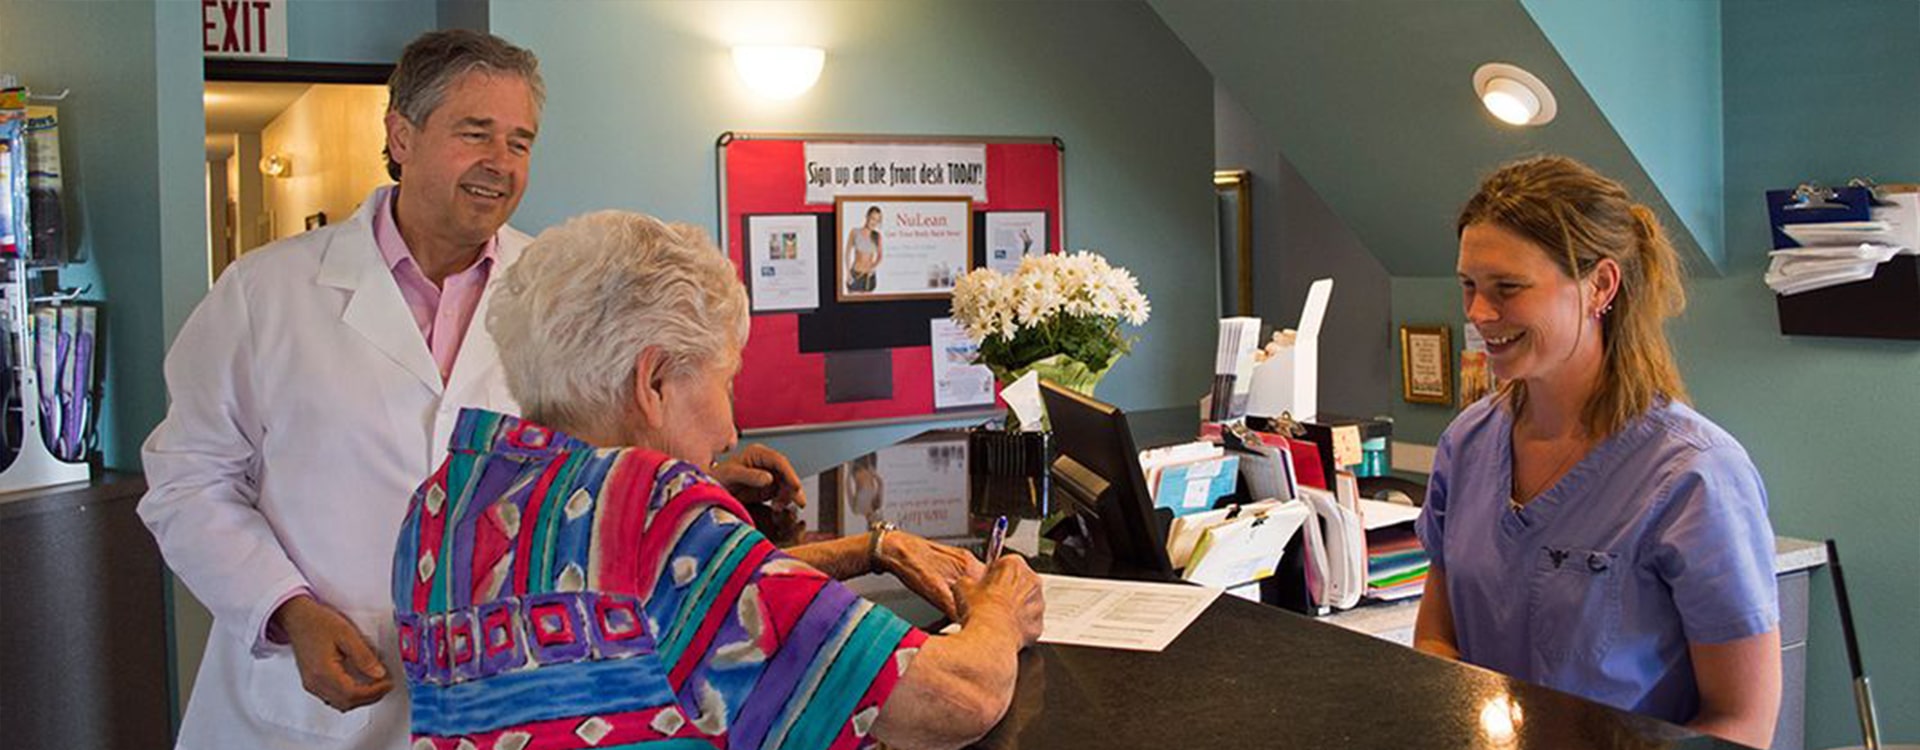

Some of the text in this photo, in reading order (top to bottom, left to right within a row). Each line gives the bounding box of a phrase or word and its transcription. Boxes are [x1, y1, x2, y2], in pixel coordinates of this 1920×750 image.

[202, 0, 271, 53] EXIT
[808, 161, 983, 187] Sign up at the front desk TODAY!
[897, 213, 948, 226] NuLean
